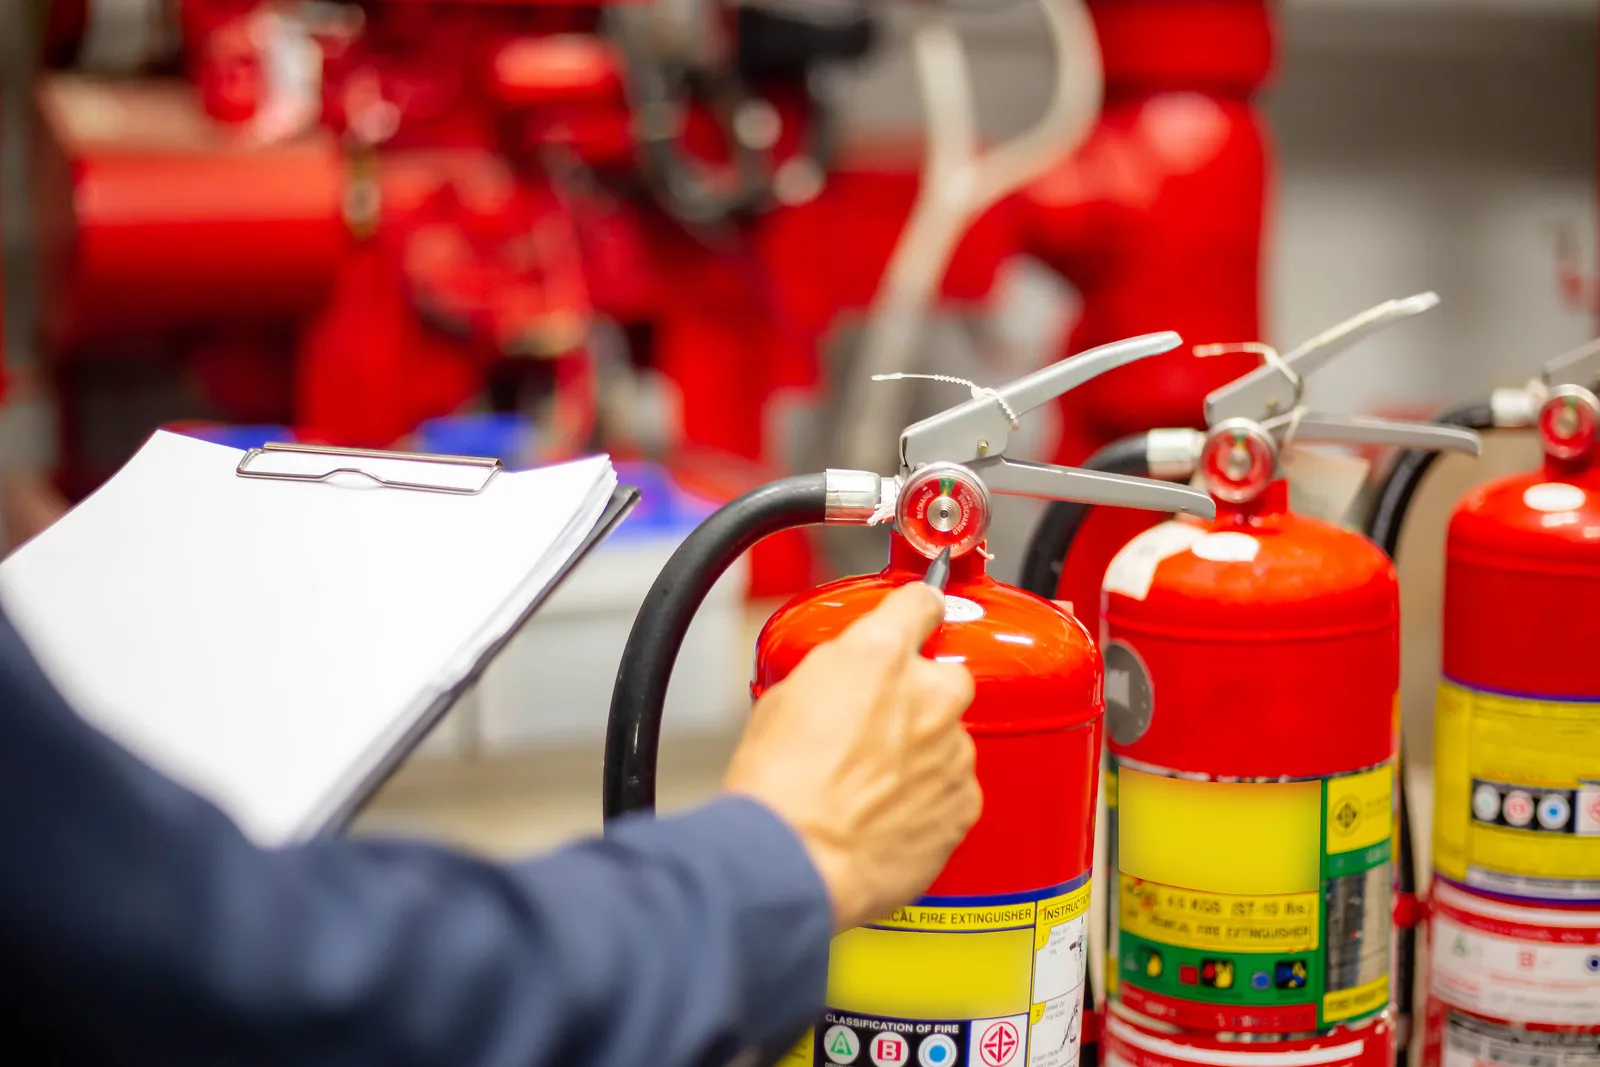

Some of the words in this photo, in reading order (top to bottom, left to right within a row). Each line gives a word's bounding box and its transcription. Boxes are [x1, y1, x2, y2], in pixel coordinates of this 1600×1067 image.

[916, 489, 934, 520] RECHARGE
[952, 493, 970, 536] OVERCHARGED
[919, 912, 947, 924] FIRE
[950, 908, 1032, 925] EXTINGUISHER
[825, 1013, 913, 1033] CLASSIFICATION
[916, 1024, 931, 1033] OF
[934, 1024, 960, 1034] FIRE
[1036, 1009, 1041, 1017] 2
